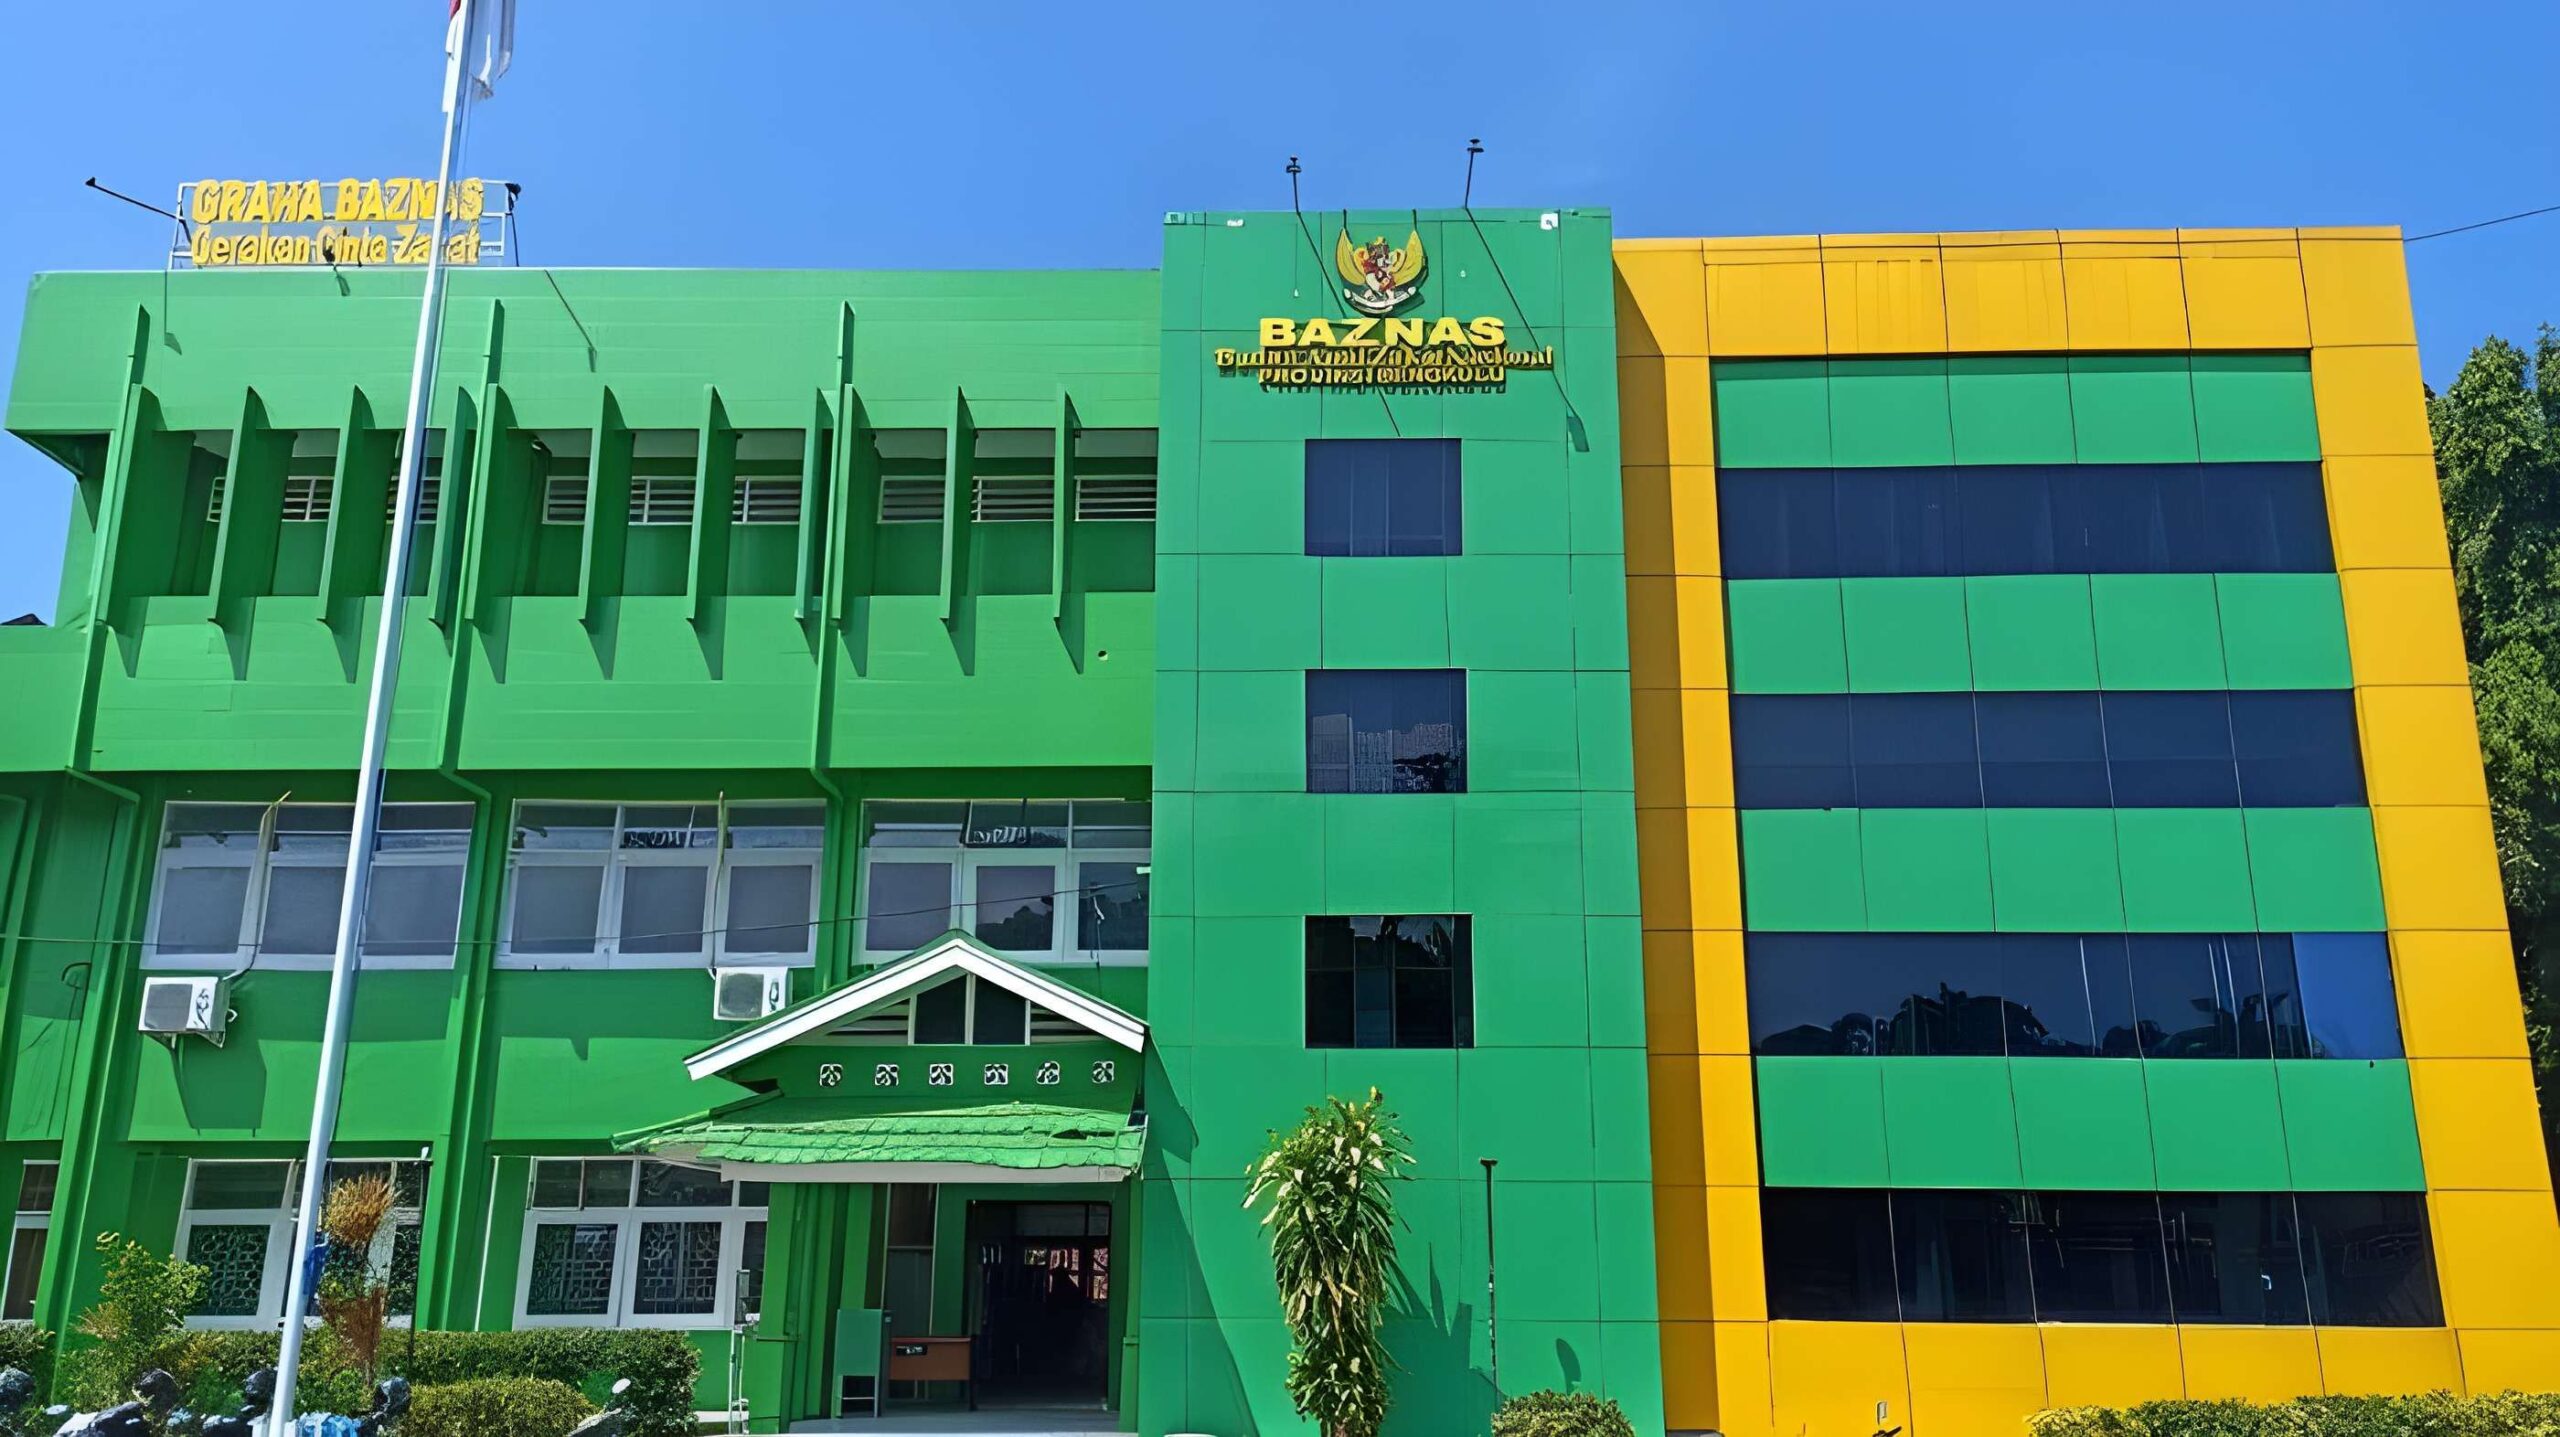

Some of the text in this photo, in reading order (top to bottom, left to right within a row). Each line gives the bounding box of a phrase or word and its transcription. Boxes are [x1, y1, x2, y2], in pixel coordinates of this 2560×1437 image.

[191, 178, 324, 225] GRAHA
[393, 222, 481, 265] Zaat
[1259, 317, 1505, 347] BAZNAS
